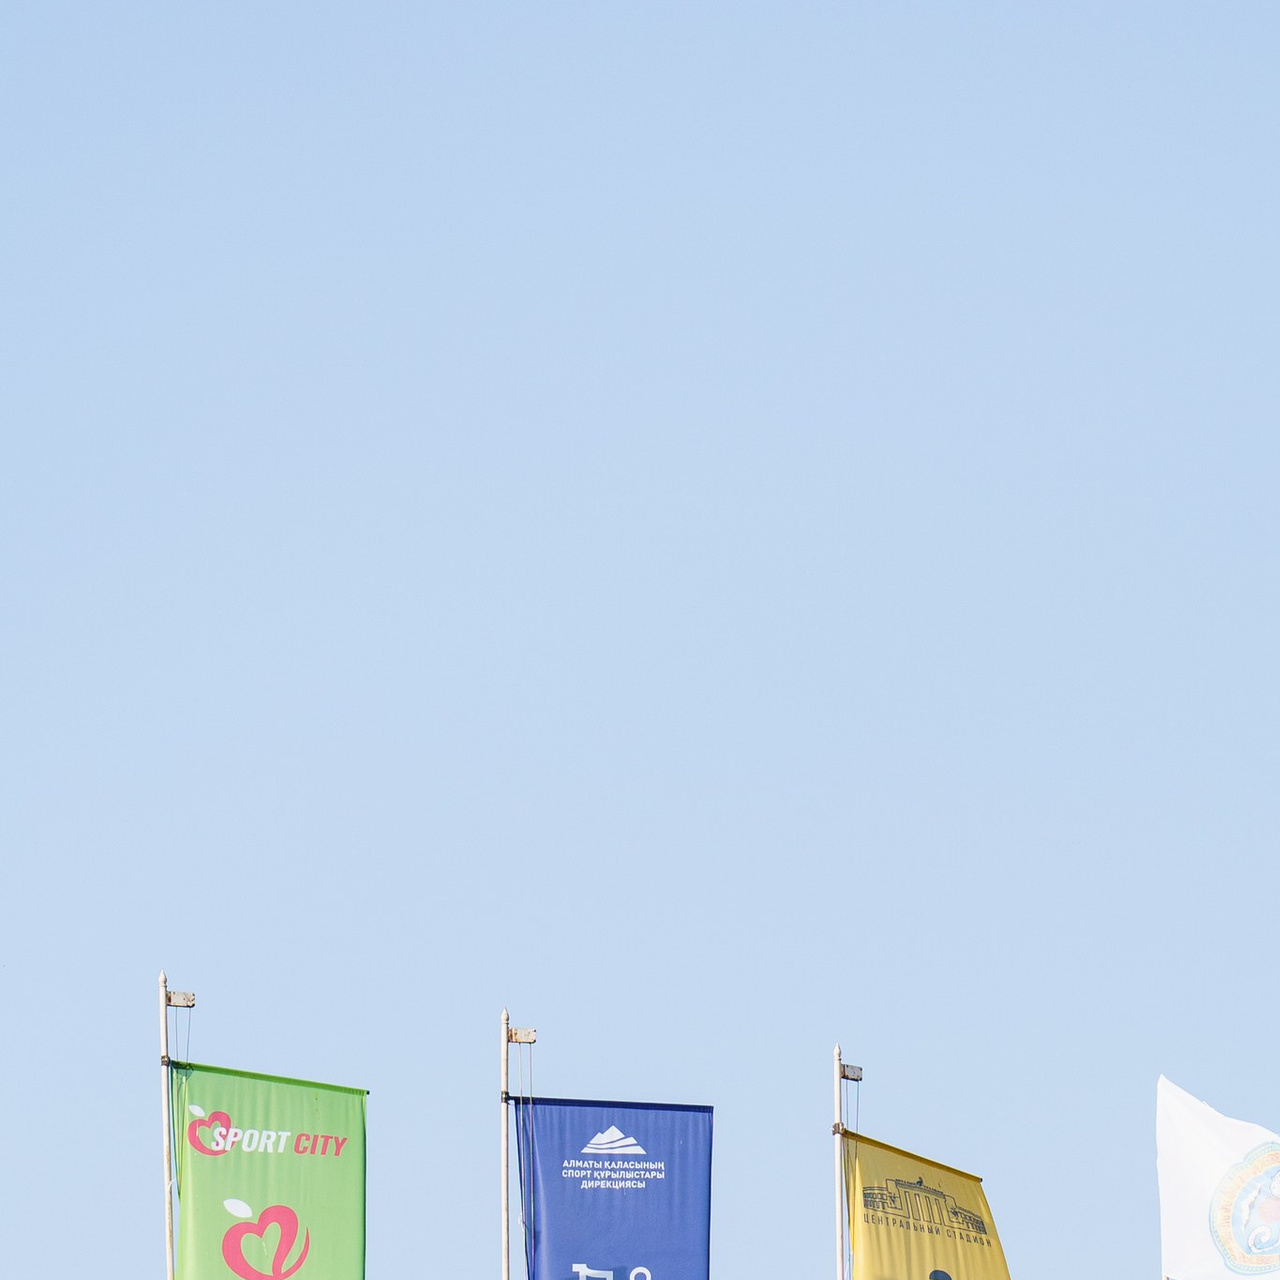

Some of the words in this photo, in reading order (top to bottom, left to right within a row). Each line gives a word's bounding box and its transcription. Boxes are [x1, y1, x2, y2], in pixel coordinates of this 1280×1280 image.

[211, 1126, 291, 1153] SPORT
[293, 1132, 348, 1157] CITY
[562, 1159, 602, 1169] АЛМАТЫ
[561, 1169, 592, 1178] СПОРТ
[580, 1180, 646, 1189] ДИРЕКЦИЯСЫ
[863, 1213, 941, 1235] ЦЕНТРАЛЬНЫЙ
[946, 1229, 992, 1247] СТАДИОН
